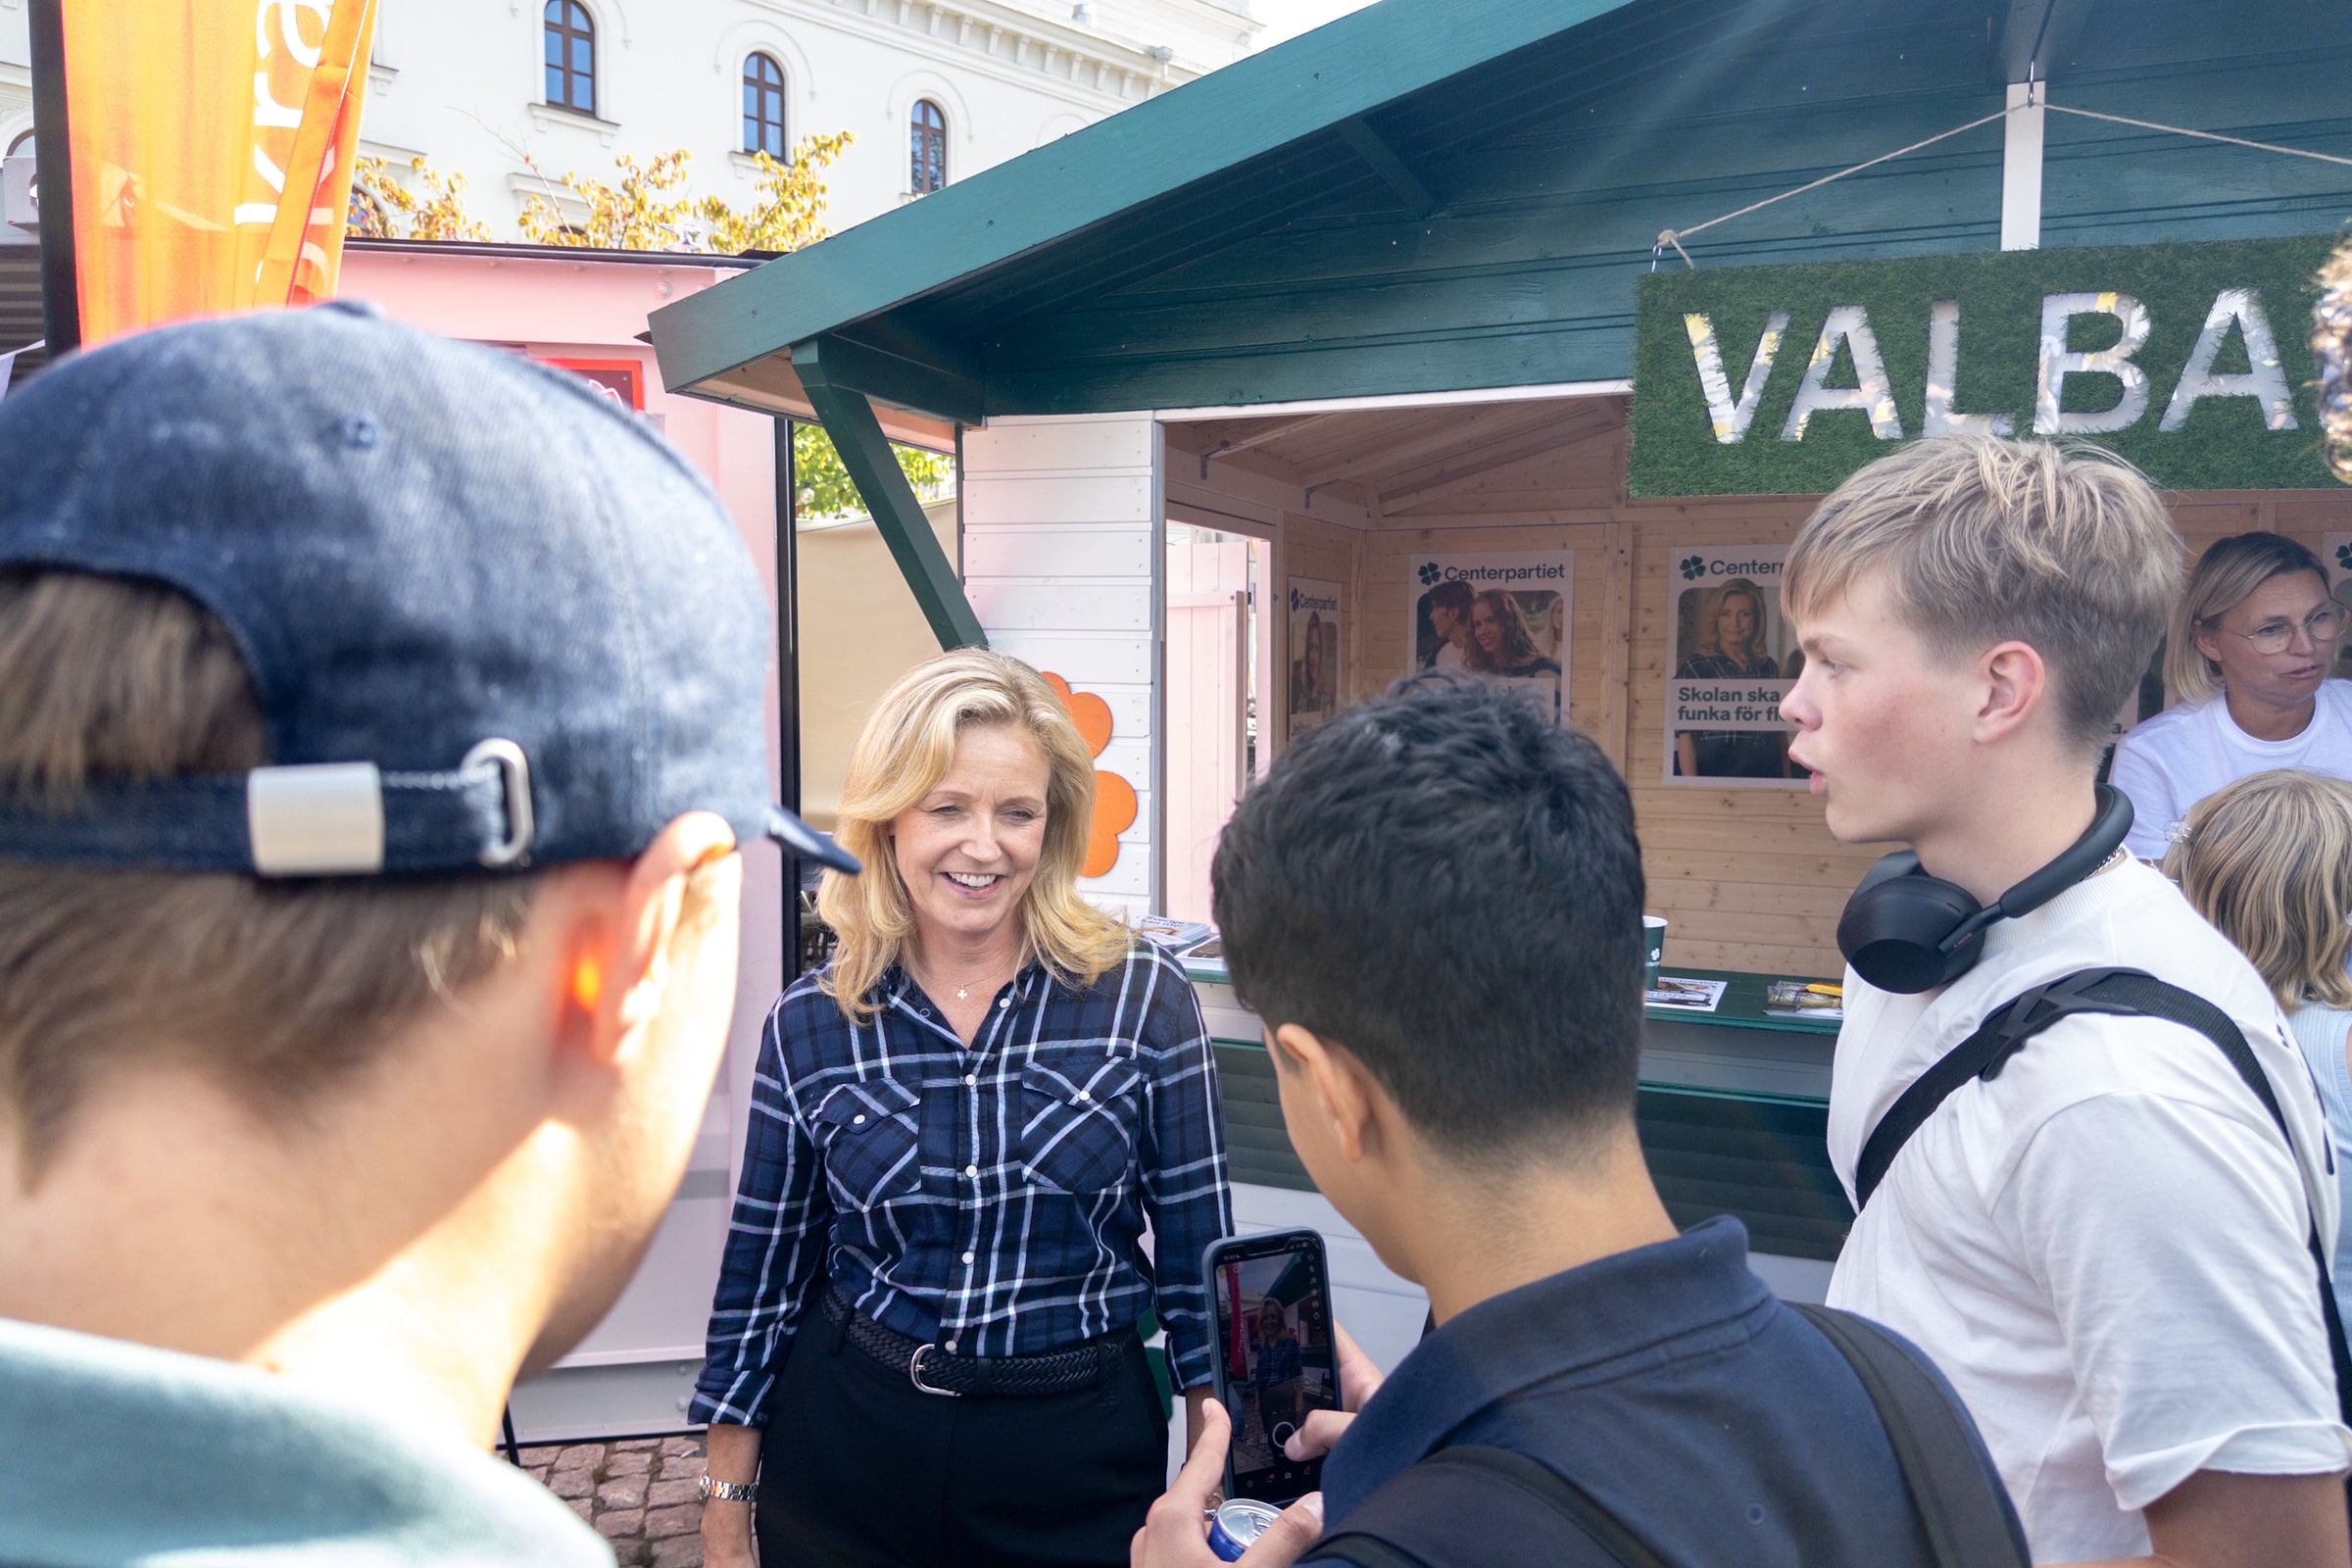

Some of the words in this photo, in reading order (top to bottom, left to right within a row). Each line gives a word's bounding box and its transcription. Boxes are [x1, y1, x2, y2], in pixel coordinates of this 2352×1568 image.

[1683, 288, 2332, 445] VALBA
[1445, 564, 1566, 583] Centerpartiet
[1678, 687, 1741, 702] Skolan
[1747, 687, 1780, 702] ska
[1678, 706, 1731, 721] funka
[1735, 706, 1762, 721] för
[1766, 706, 1785, 721] fl
[1953, 932, 1973, 949] SONY
